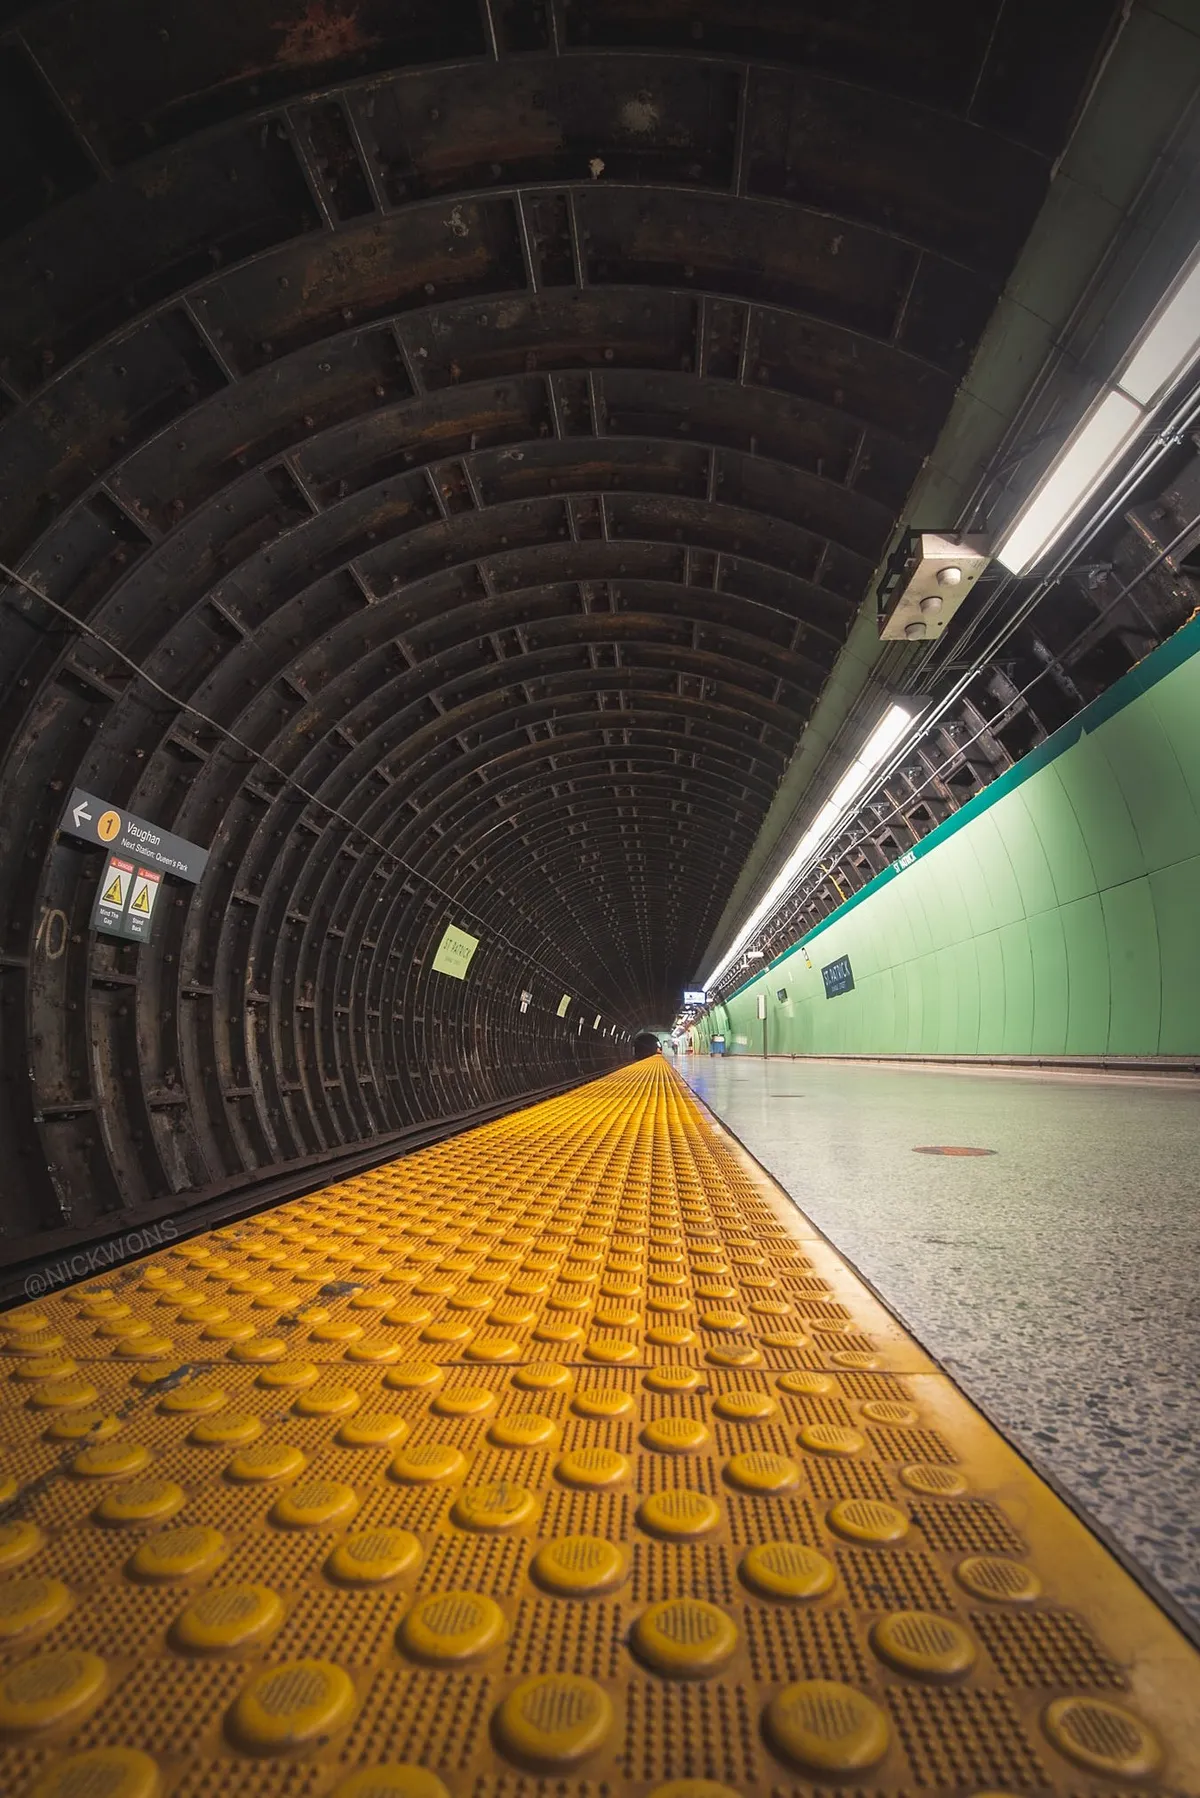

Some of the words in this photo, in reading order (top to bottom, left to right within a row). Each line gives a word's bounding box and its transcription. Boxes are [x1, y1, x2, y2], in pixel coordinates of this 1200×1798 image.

[105, 818, 113, 834] 1
[127, 821, 160, 845] Vaughan
[120, 838, 135, 850] Next
[135, 843, 156, 859] Station:
[155, 852, 176, 867] Queen's
[176, 861, 188, 872] Park
[117, 861, 134, 873] DANGER
[100, 908, 111, 917] Mind
[111, 911, 119, 919] The
[103, 917, 113, 926] Gap
[132, 917, 144, 926] Stand
[131, 924, 142, 932] Back
[829, 960, 851, 982] PATRICK
